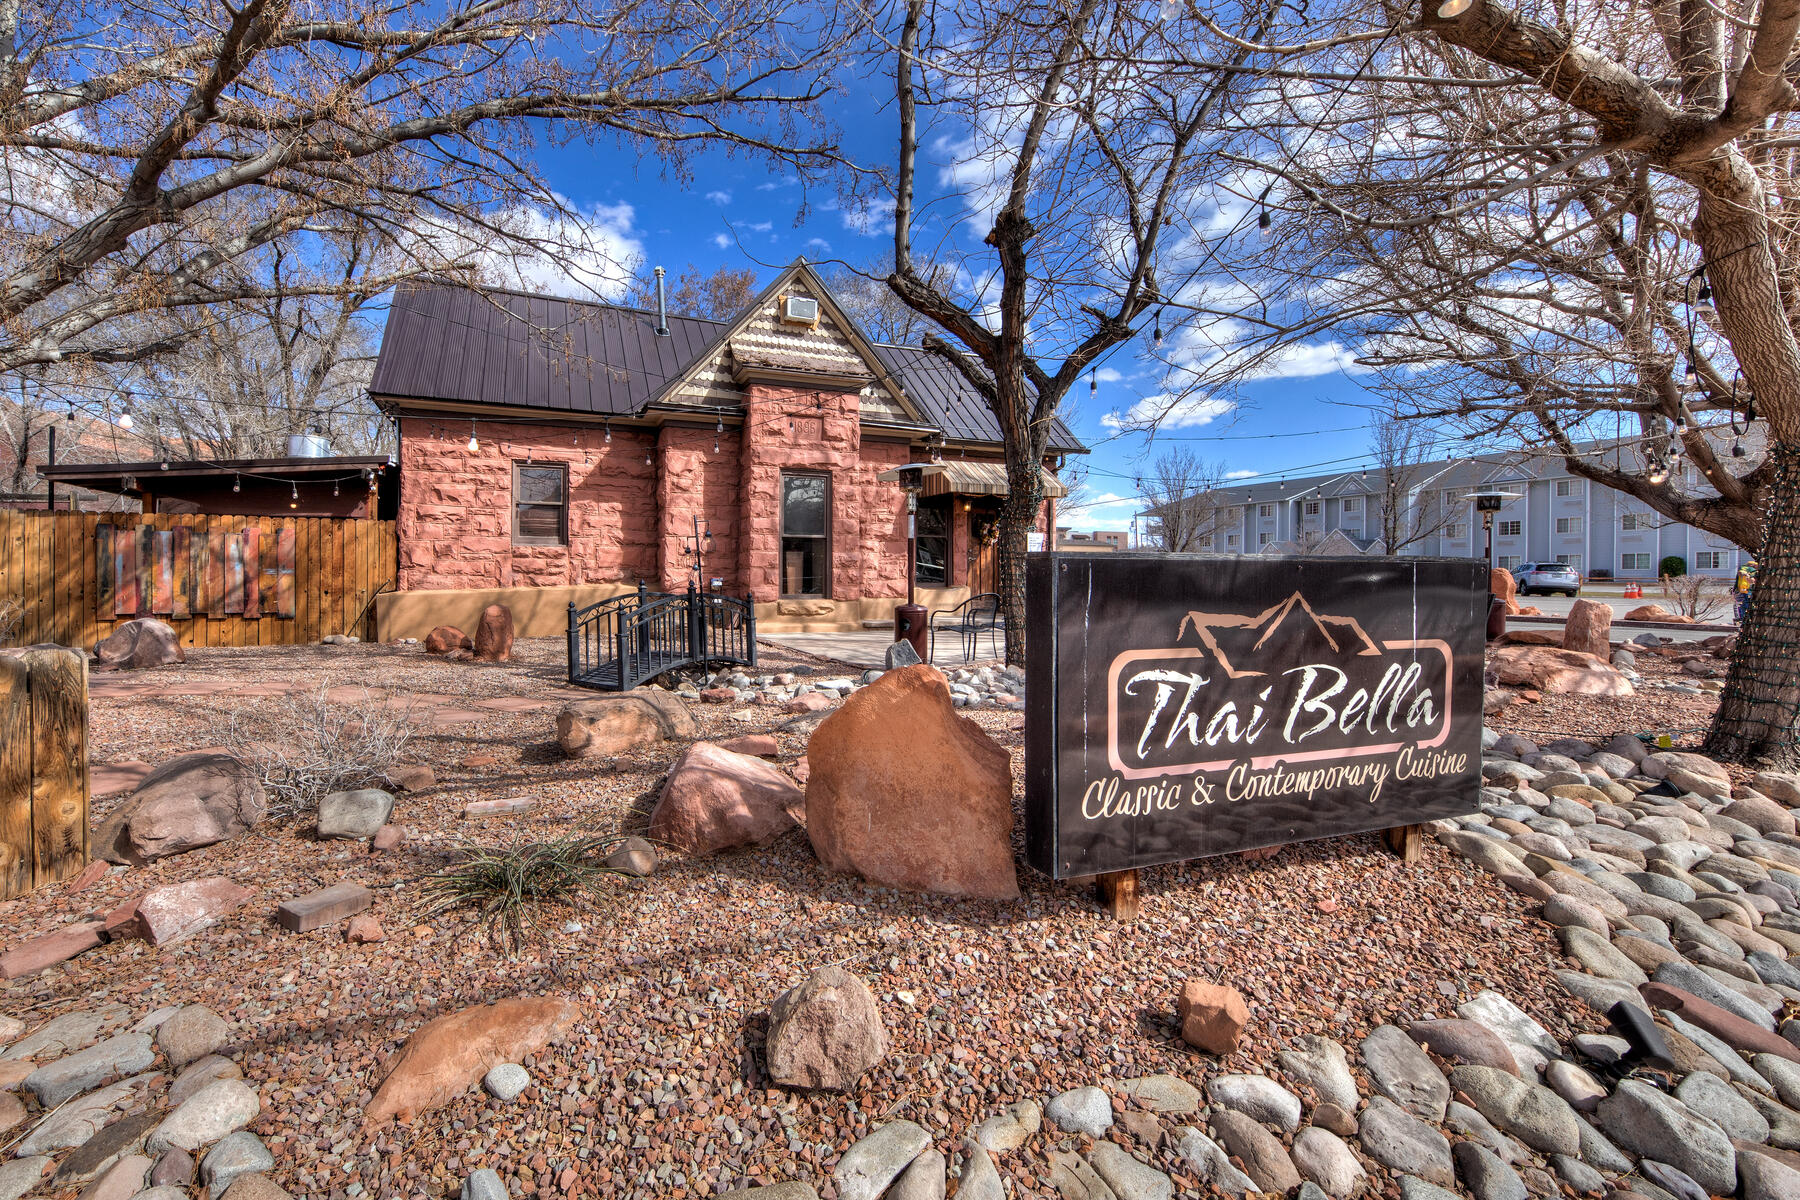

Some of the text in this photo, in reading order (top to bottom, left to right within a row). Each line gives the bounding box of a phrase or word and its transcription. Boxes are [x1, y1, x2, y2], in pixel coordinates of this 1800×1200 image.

[794, 420, 816, 434] 1896
[1125, 662, 1439, 760] Thai Bella
[1081, 747, 1467, 820] Classic & Contemporary Cuisine
